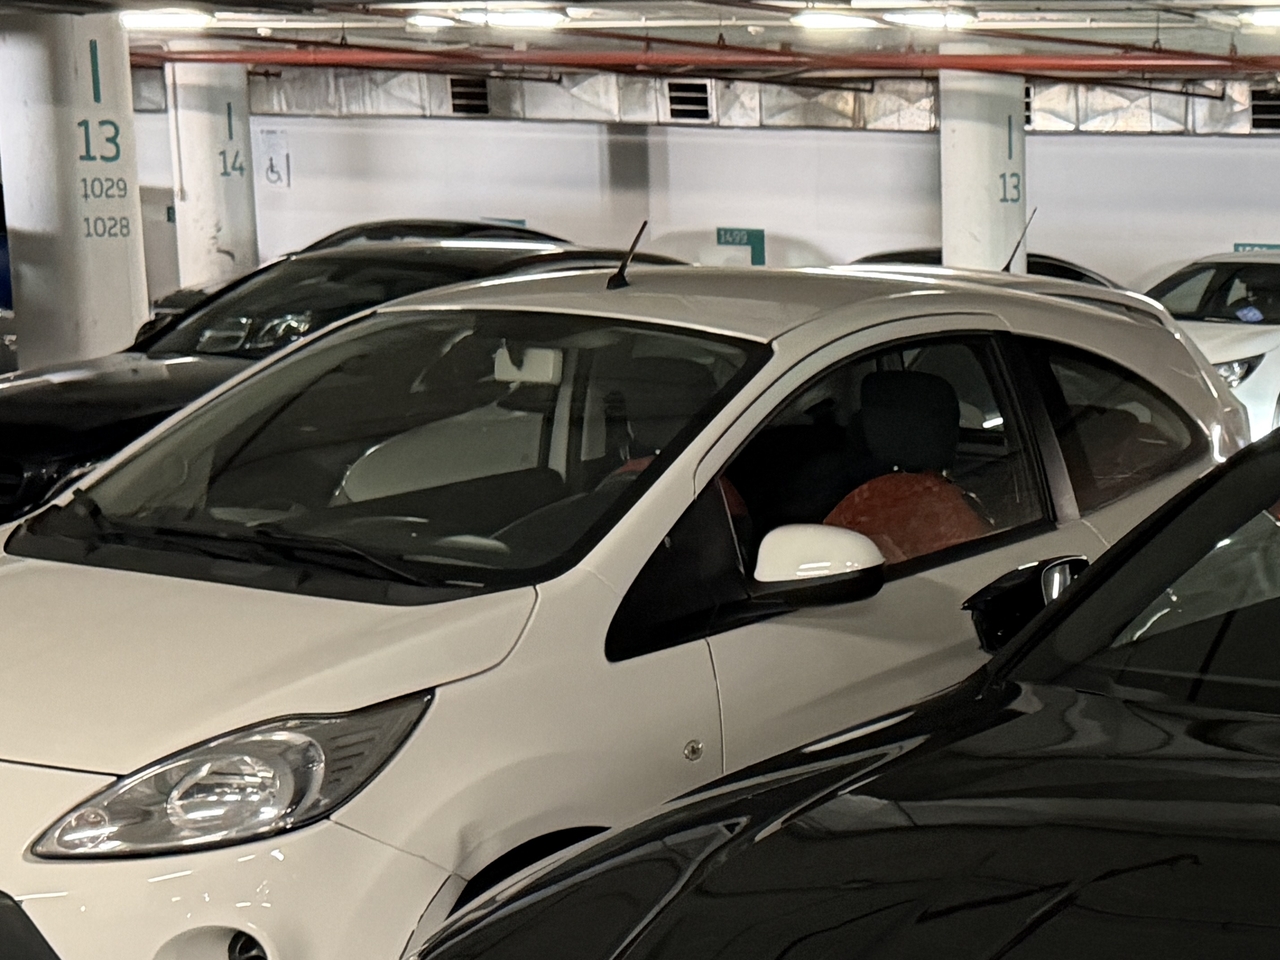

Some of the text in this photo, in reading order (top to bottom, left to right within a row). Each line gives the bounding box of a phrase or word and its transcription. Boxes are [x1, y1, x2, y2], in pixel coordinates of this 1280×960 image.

[77, 118, 121, 163] 13
[218, 149, 246, 177] 14
[79, 177, 128, 201] 1029
[999, 171, 1022, 203] 13
[83, 216, 131, 238] 1028
[720, 230, 748, 244] 1499
